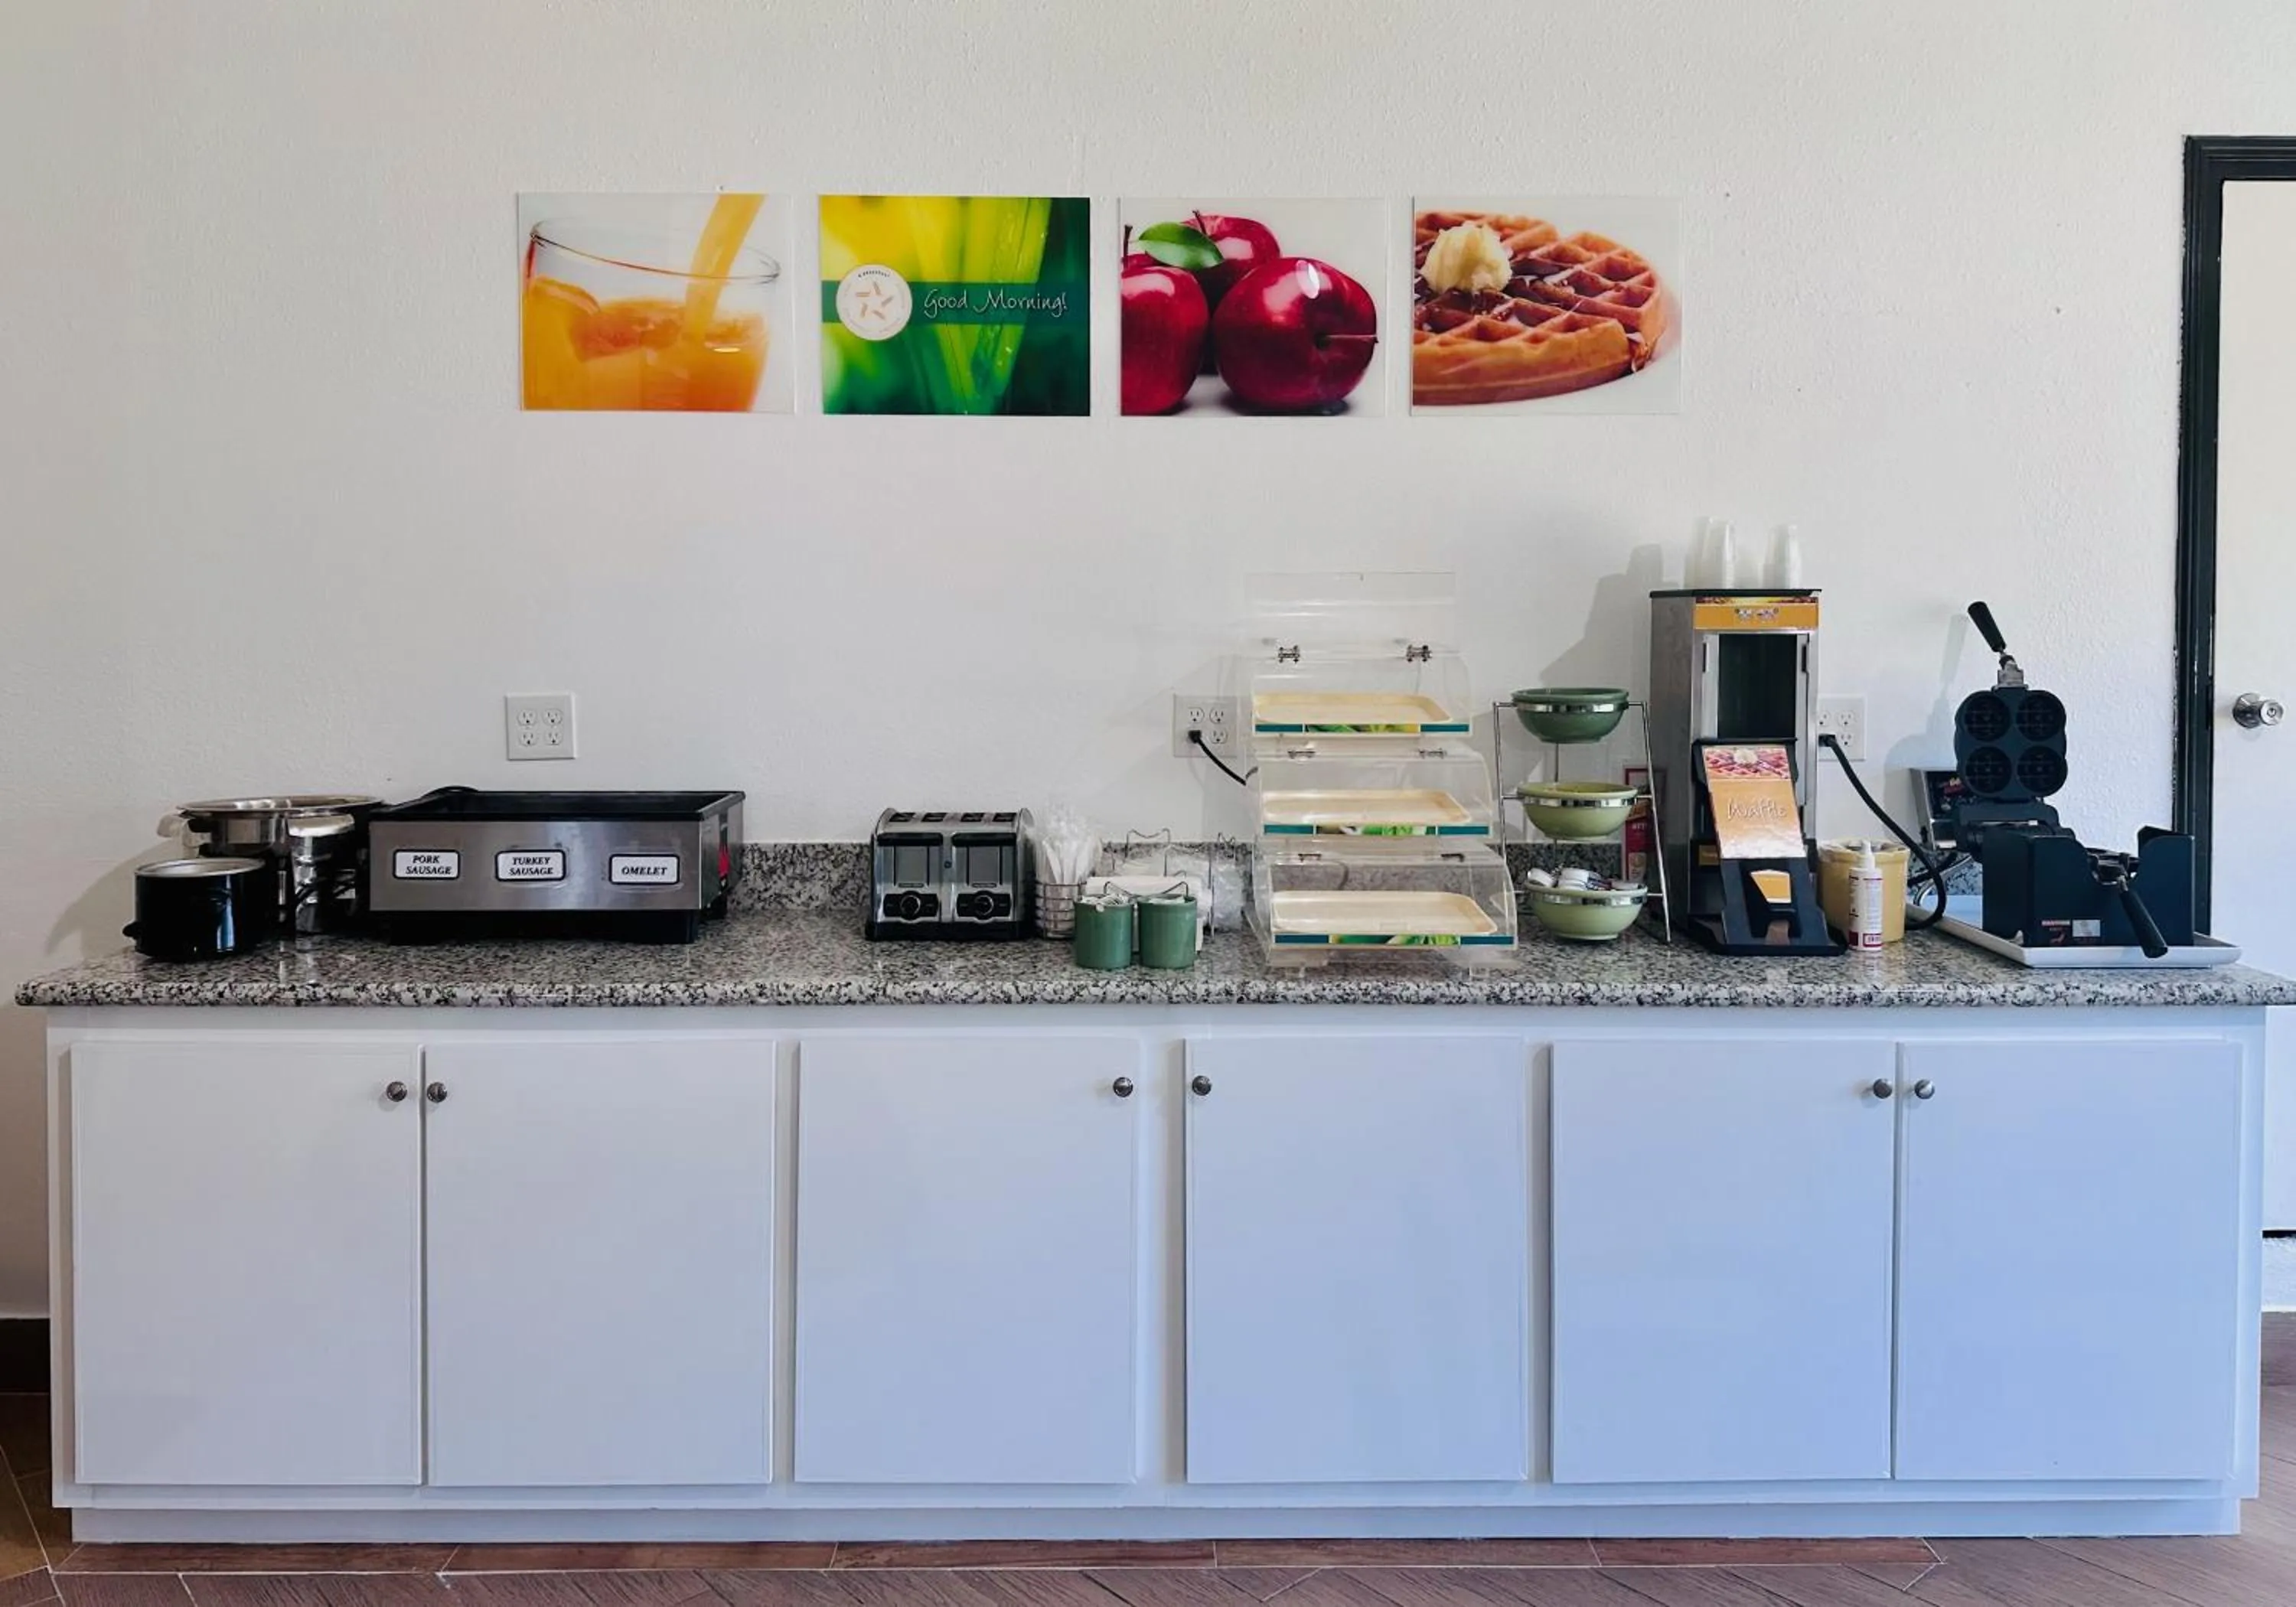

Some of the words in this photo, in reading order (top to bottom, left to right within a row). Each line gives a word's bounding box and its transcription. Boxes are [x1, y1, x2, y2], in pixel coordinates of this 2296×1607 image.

[924, 288, 968, 319] Good
[973, 287, 1068, 318] Morning!
[413, 855, 440, 864] PORK
[512, 856, 551, 865] TURKEY
[405, 865, 452, 875] SAUSAGE
[509, 867, 553, 876] SAUSAGE
[621, 865, 667, 875] OMELET
